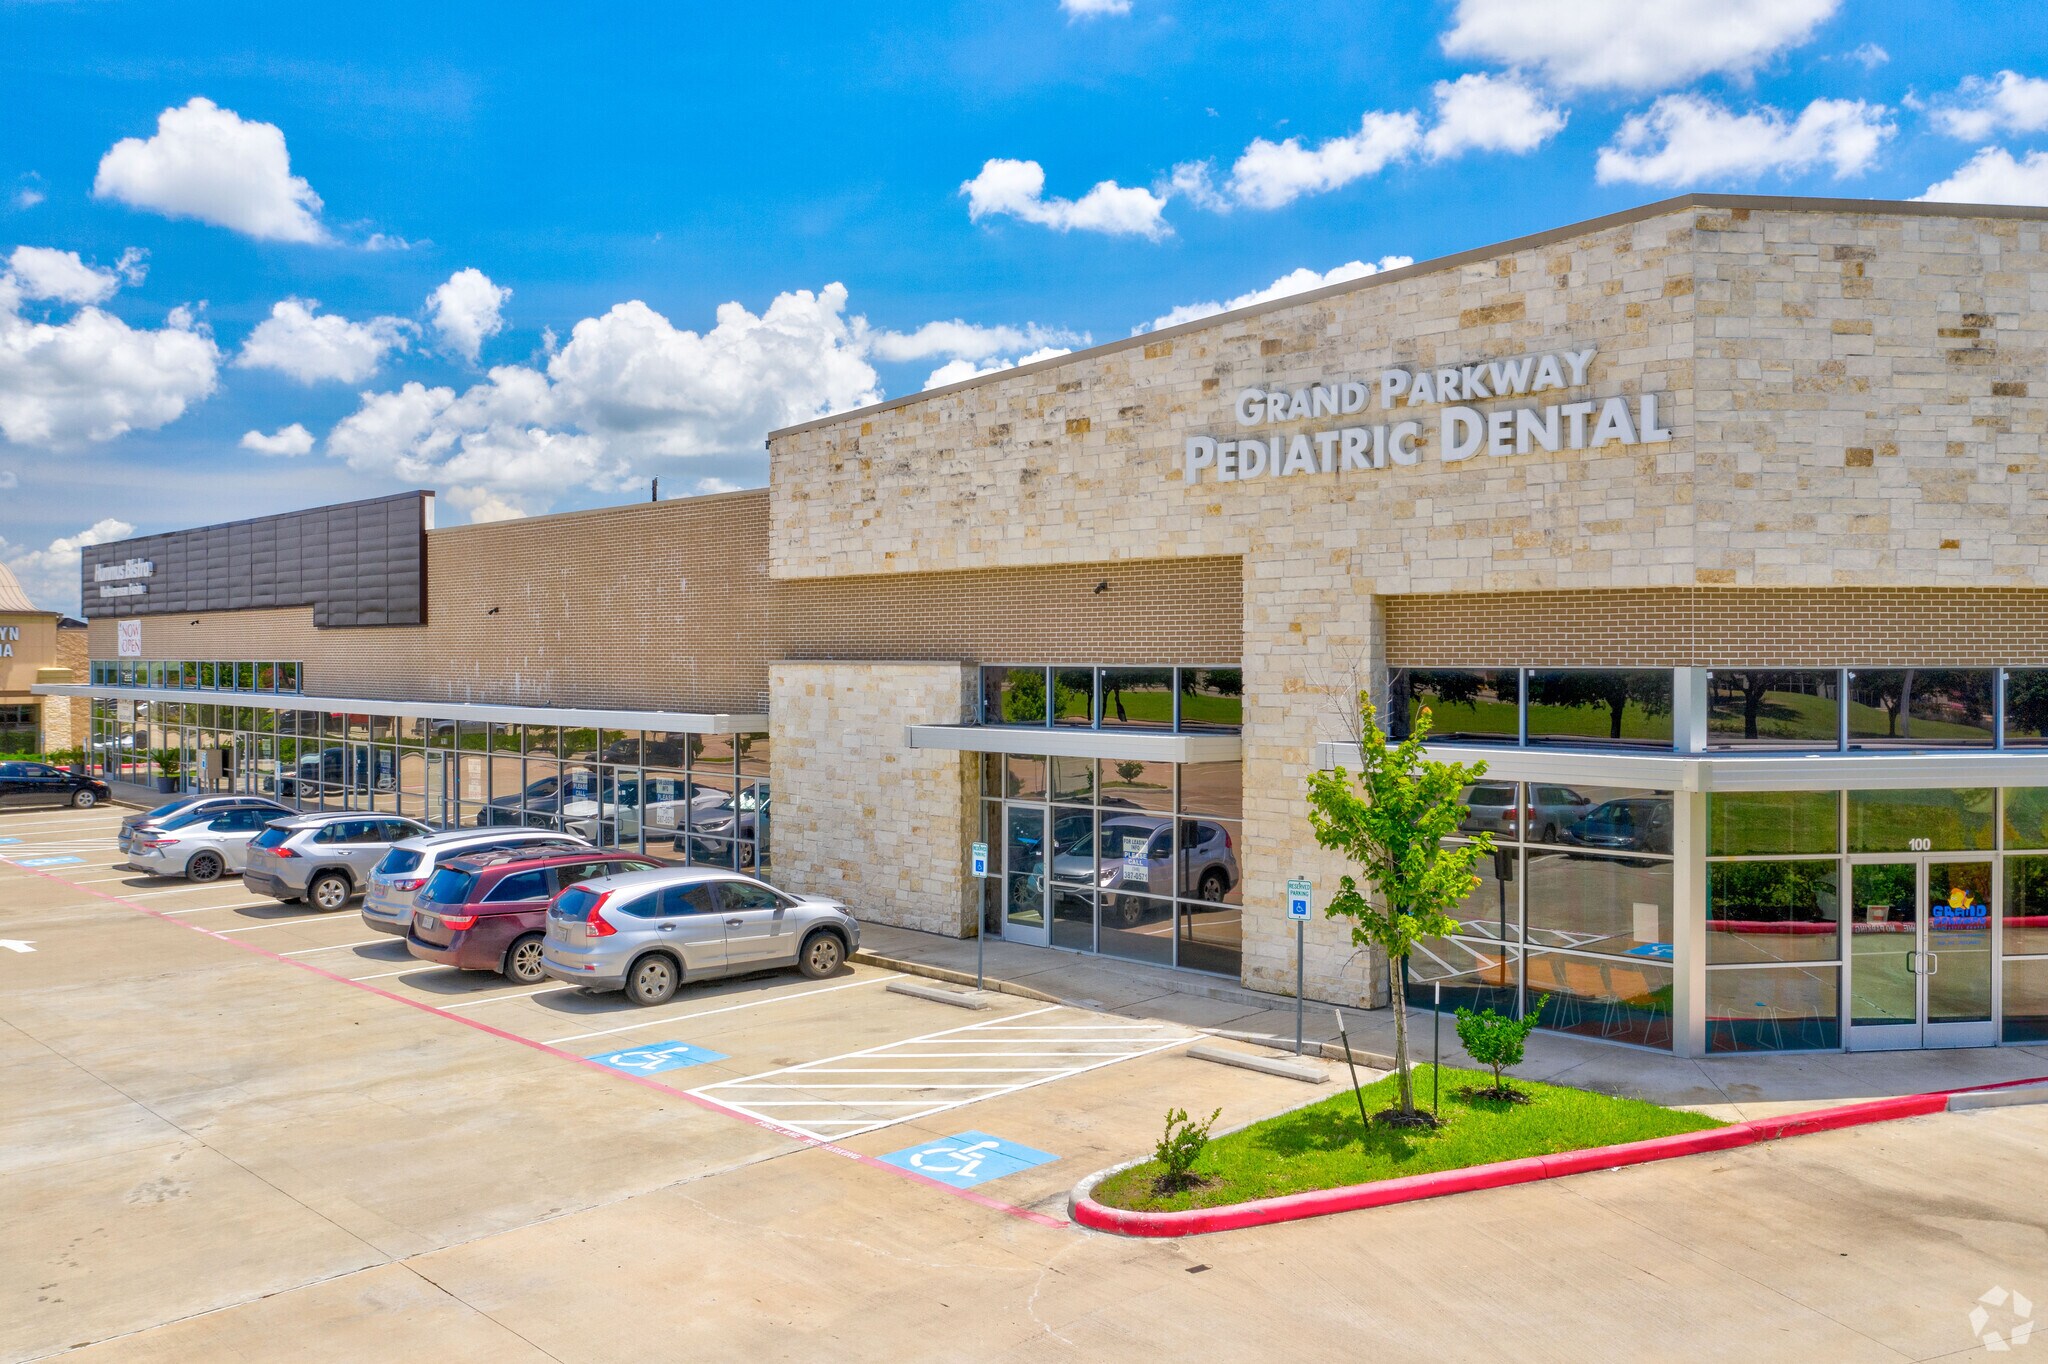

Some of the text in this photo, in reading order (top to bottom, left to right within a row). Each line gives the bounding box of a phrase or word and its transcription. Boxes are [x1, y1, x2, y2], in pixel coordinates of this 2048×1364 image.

[1235, 349, 1597, 427] GRAND PARKWAY
[1185, 393, 1672, 486] PEDIATRIC DENTAL
[122, 623, 139, 638] NOW
[121, 639, 140, 653] OPEN
[1908, 837, 1931, 851] 100
[1128, 858, 1144, 866] CALL
[1932, 904, 1987, 918] GRAND
